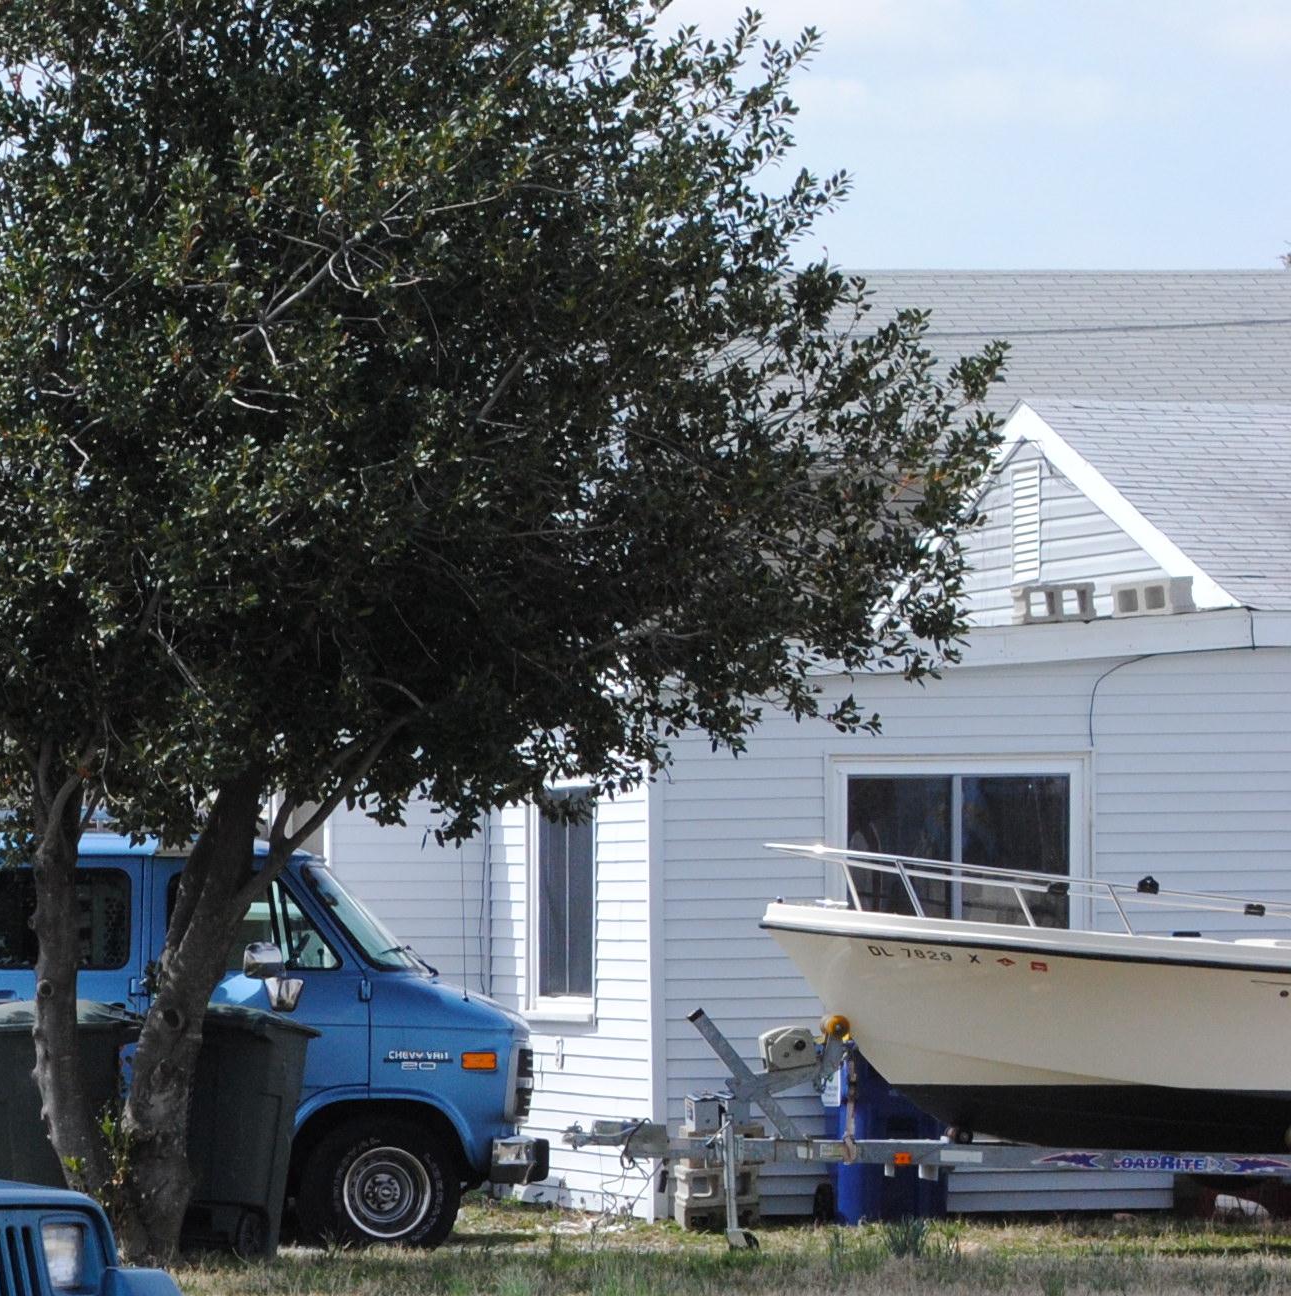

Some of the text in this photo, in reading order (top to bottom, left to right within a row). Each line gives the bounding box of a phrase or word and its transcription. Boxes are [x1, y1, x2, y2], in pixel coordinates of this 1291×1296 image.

[867, 945, 894, 957] DL
[968, 953, 981, 965] X
[388, 1050, 449, 1060] CHEVY VAN
